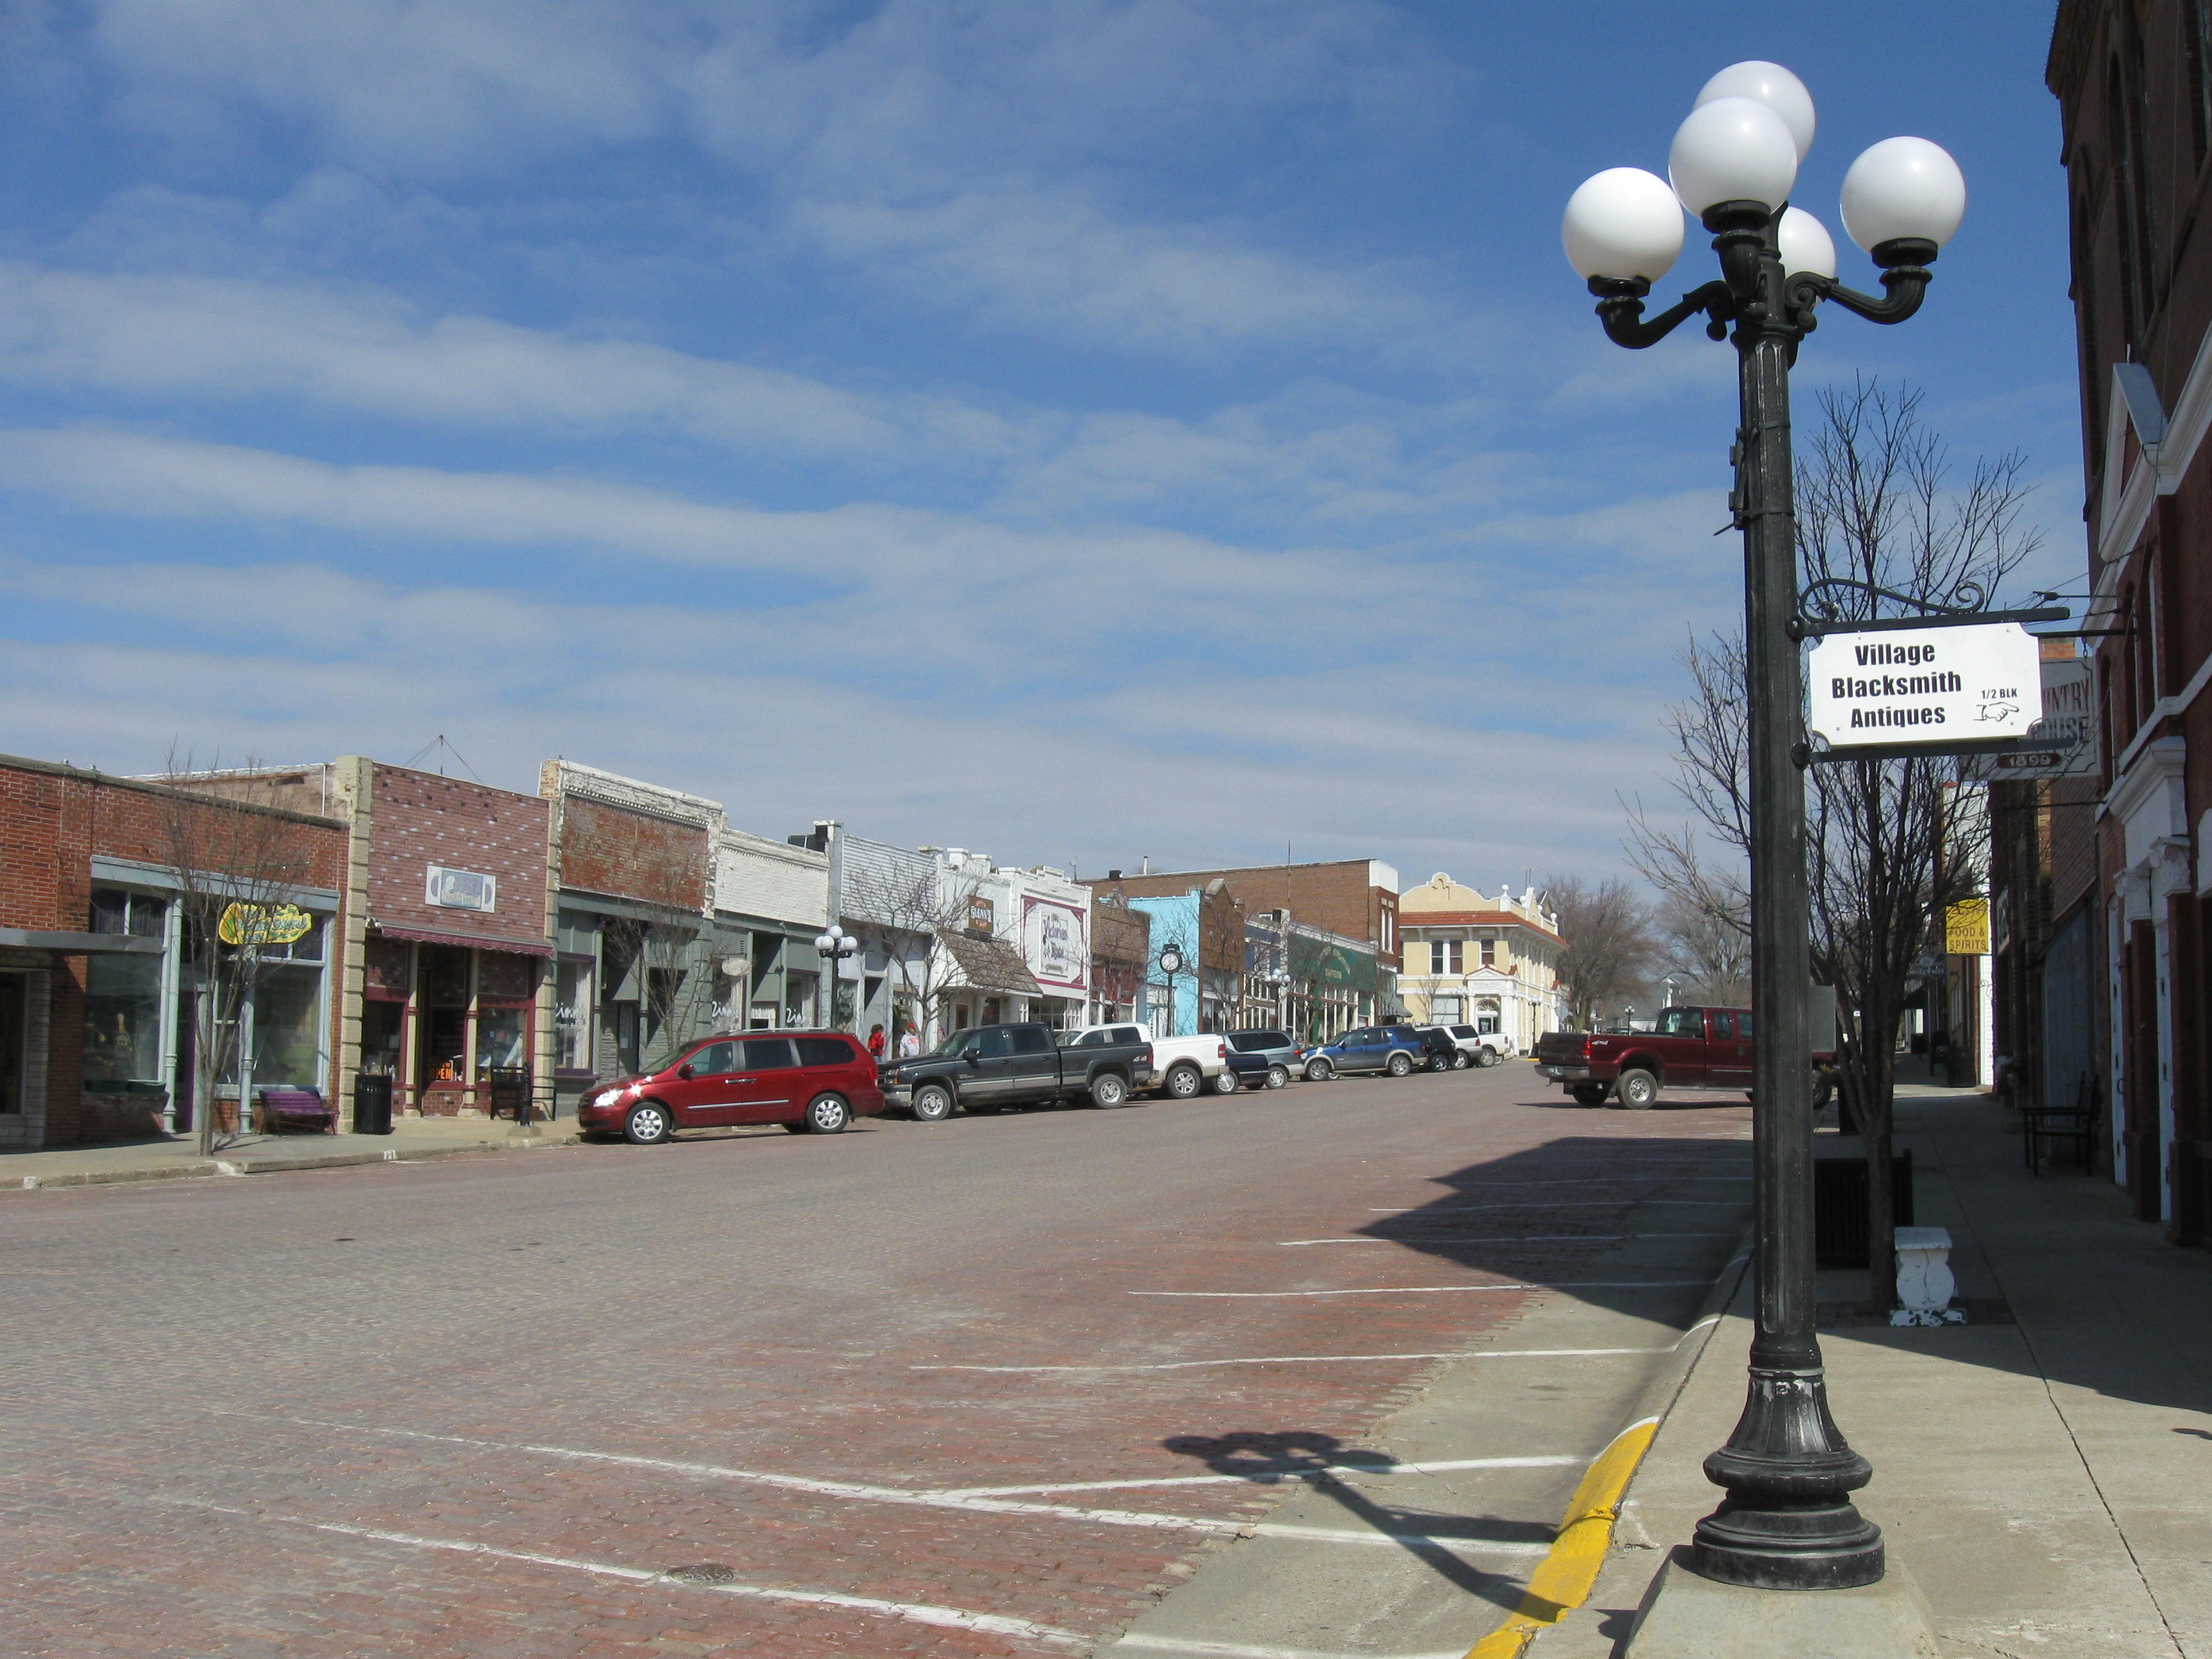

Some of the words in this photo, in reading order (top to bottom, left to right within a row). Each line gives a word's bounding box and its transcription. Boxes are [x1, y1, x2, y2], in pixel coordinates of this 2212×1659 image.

[1854, 643, 1936, 666] Village
[1832, 671, 1962, 699] Blacksmith
[1981, 689, 1996, 699] 1/2
[1999, 688, 2018, 698] BLK
[2043, 678, 2089, 713] UNTRY
[1850, 705, 1946, 729] Antiques
[2009, 757, 2051, 767] 1899
[1949, 926, 1975, 937] FOOD
[1979, 926, 1985, 937] &
[1948, 939, 1986, 950] SPIRITS
